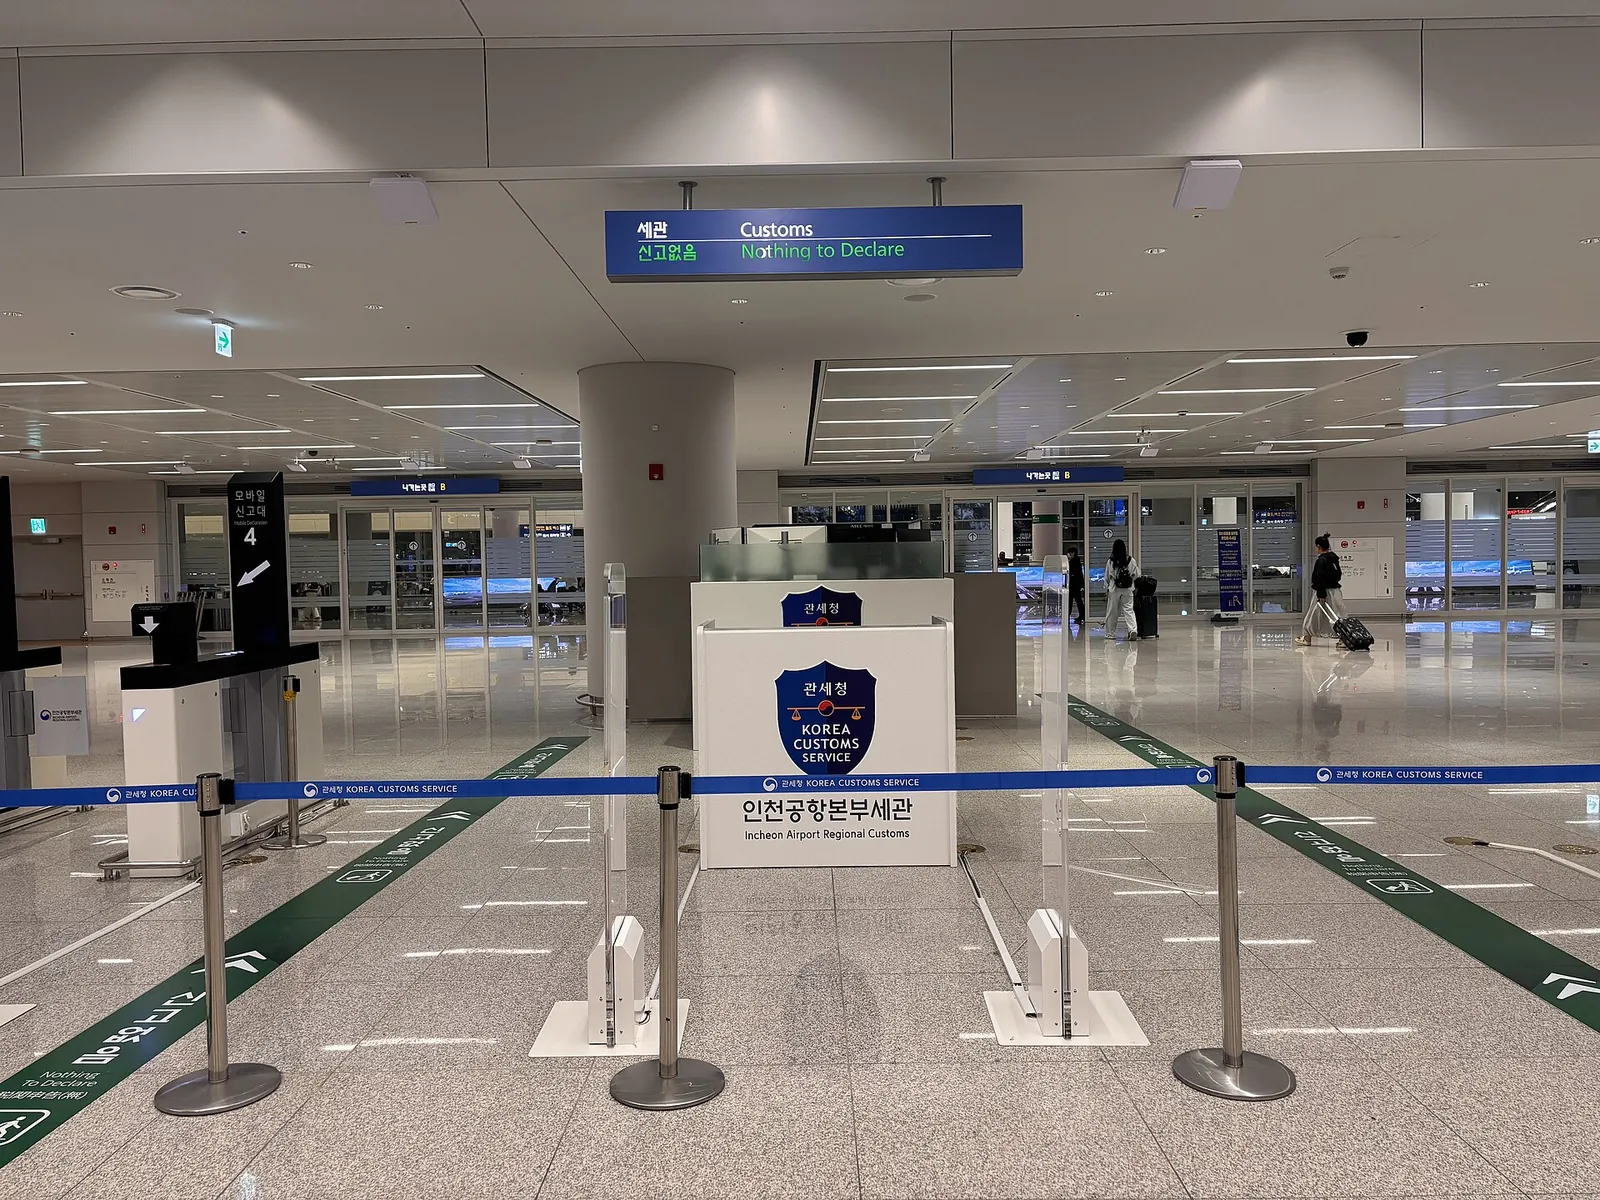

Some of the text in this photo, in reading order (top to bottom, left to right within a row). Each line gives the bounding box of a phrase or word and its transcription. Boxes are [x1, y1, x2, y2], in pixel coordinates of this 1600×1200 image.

[637, 221, 668, 239] 세관
[740, 222, 813, 237] Customs
[638, 243, 697, 261] 신고없음
[741, 241, 904, 262] Nothing to Declare
[1064, 471, 1071, 479] B
[440, 482, 446, 491] B
[235, 489, 265, 503] 모바일
[235, 505, 266, 518] 신고대
[243, 527, 257, 546] 4
[804, 602, 839, 615] 관세청
[803, 682, 847, 697] 관세청
[802, 724, 851, 736] KOREA
[793, 738, 859, 750] CUSTOMS
[802, 752, 851, 763] SERVICE
[1336, 770, 1483, 779] 관세청 KOREA CUSTOMS SERVICE
[346, 785, 375, 793] KOREA
[377, 785, 420, 793] CUSTOMS
[421, 785, 458, 793] SERVICE
[782, 778, 919, 788] 관세청 KOREA CUSTOMS SERVICE
[150, 789, 180, 798] KOREA
[743, 798, 913, 823] 인천공항본부세관
[745, 828, 910, 841] Incheon Airport Regional Customs
[71, 990, 207, 1064] 신고없음
[39, 1071, 100, 1080] Nothing
[22, 1079, 98, 1087] To Declare
